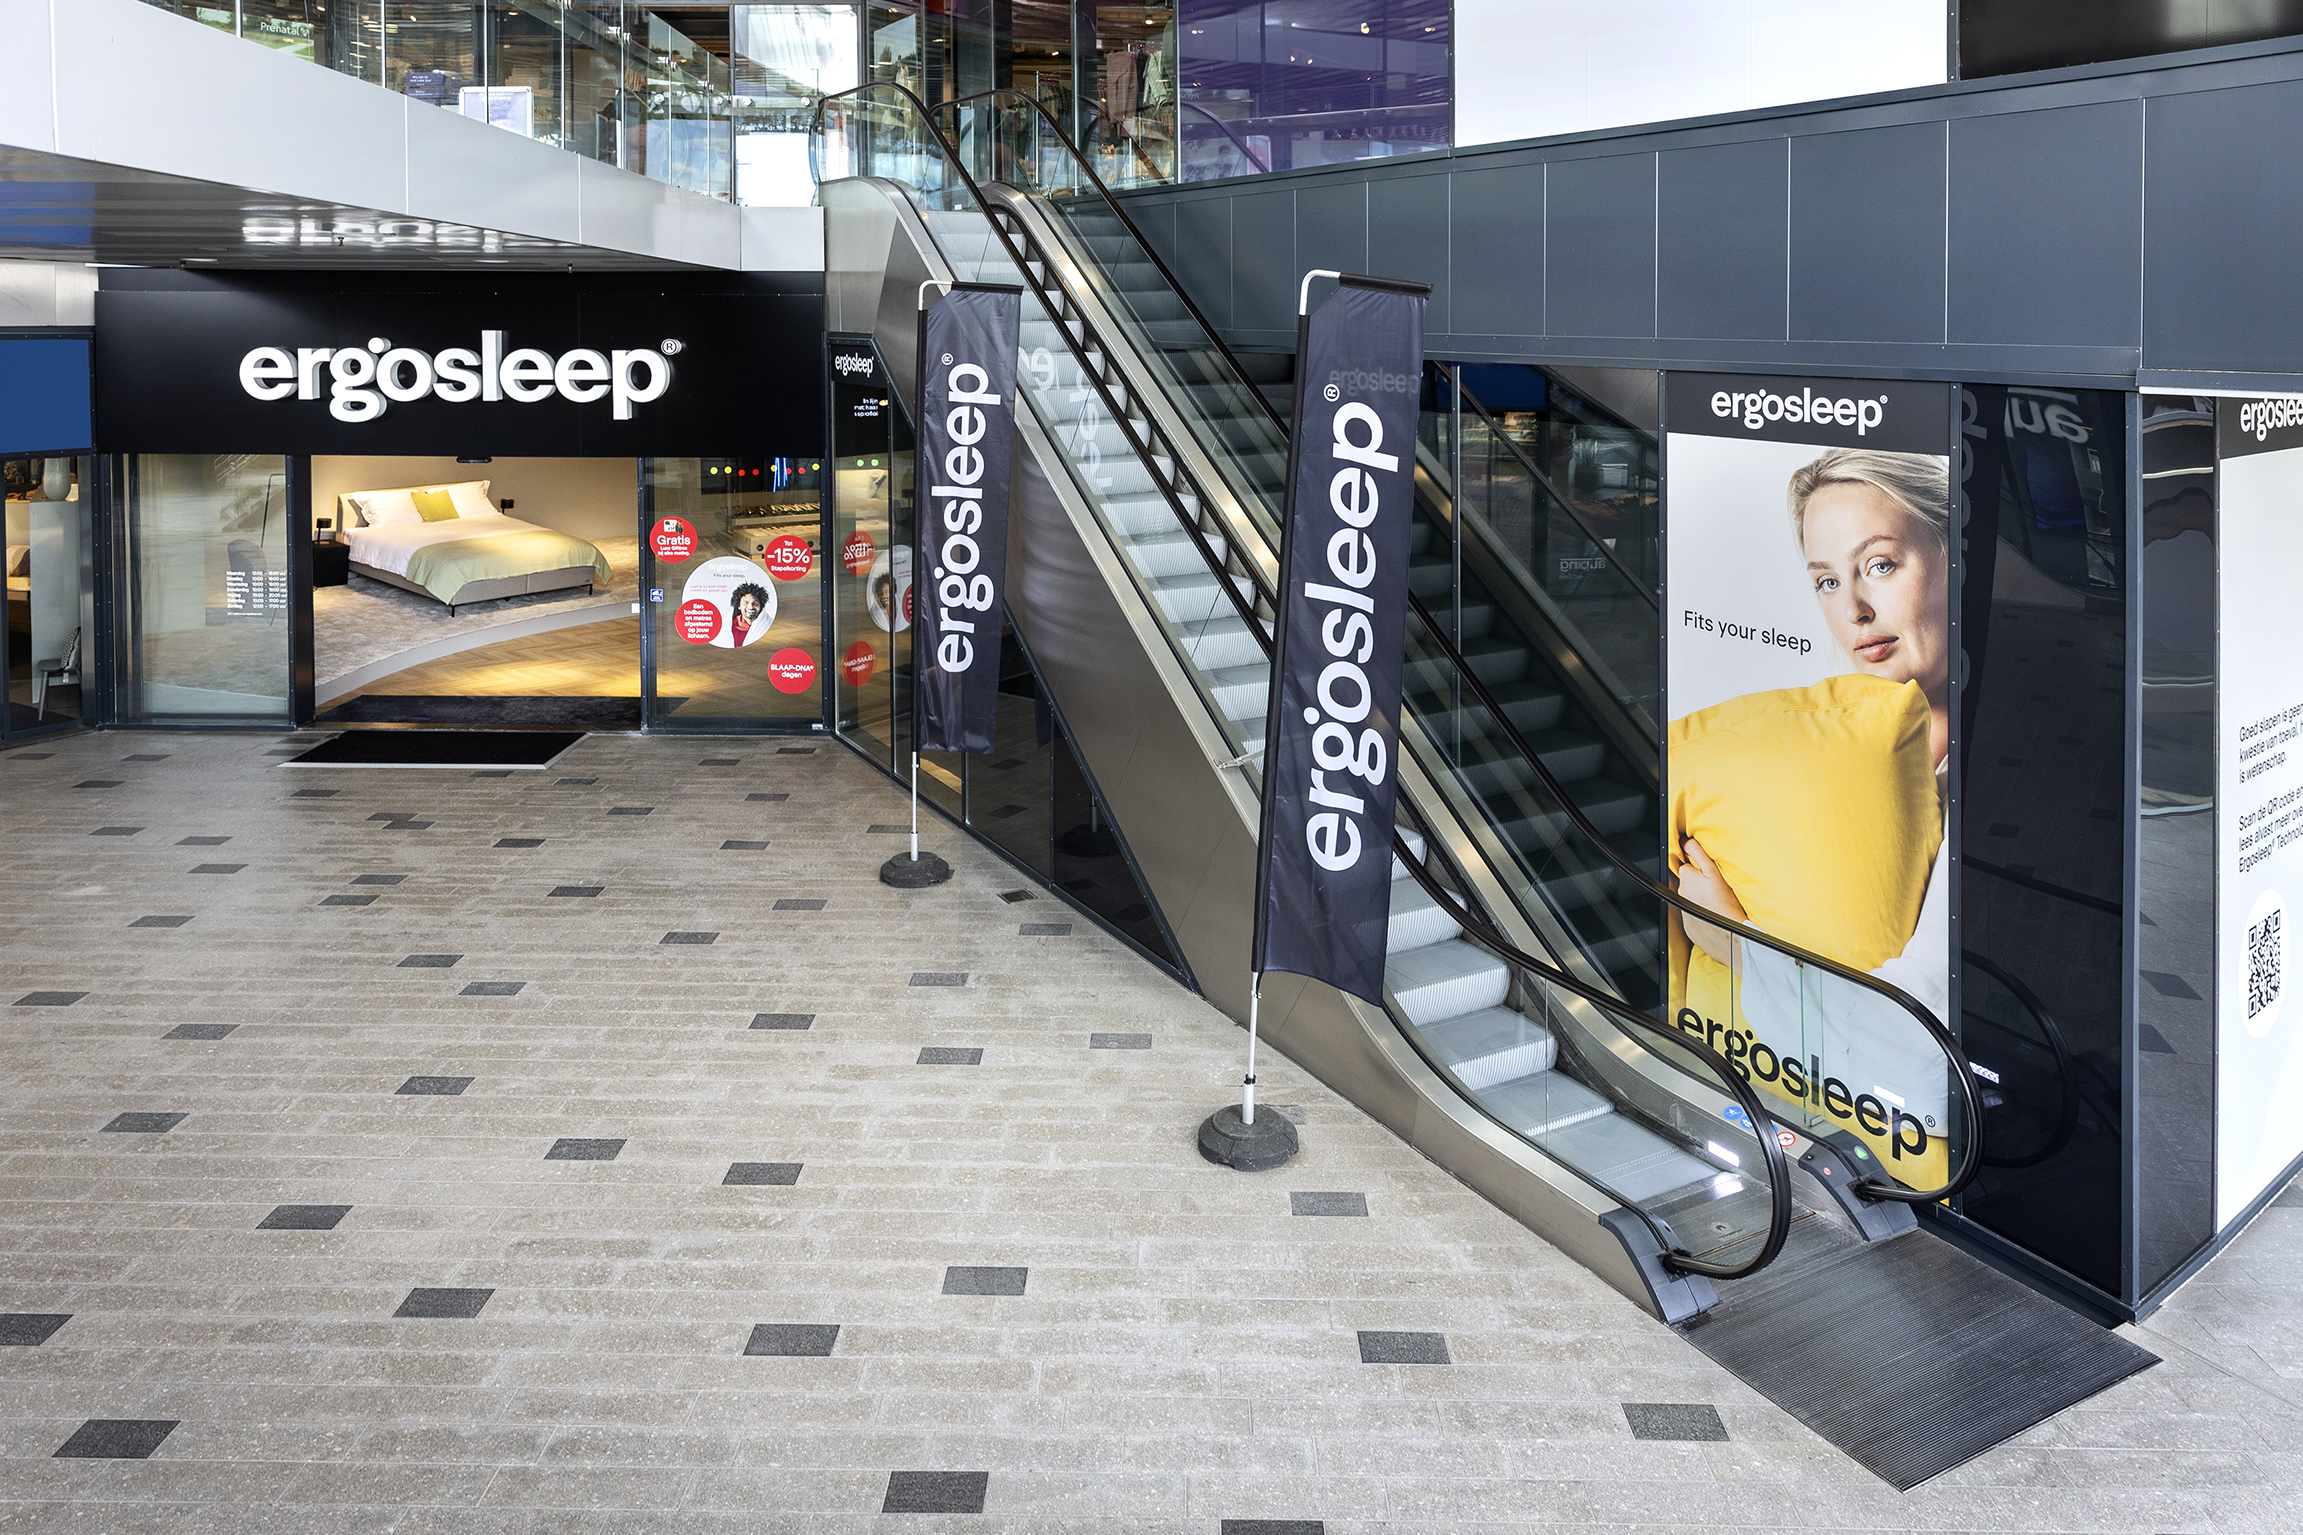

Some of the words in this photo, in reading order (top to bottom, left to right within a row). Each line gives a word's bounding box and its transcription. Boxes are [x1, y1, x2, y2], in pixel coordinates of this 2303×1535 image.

[2240, 397, 2303, 442] ergoslee
[656, 535, 691, 546] Gratis
[767, 548, 810, 564] -15%
[1684, 610, 1714, 632] Fits
[1718, 620, 1757, 639] your
[1761, 627, 1812, 656] sleep
[781, 671, 803, 679] dagen
[2240, 720, 2258, 742] Goed
[2260, 717, 2280, 733] slapen
[2282, 708, 2287, 723] is
[2240, 739, 2265, 763] kwestie
[2266, 735, 2277, 750] van
[2239, 769, 2245, 784] is
[2246, 751, 2287, 780] wetenschap.
[2239, 813, 2256, 831] Scan
[2257, 805, 2266, 821] de
[2267, 797, 2277, 815] QR
[2279, 789, 2295, 808] code
[2239, 835, 2253, 852] lees
[2254, 821, 2273, 843] alvast
[2275, 812, 2291, 831] meer
[2292, 806, 2303, 820] ove
[2277, 822, 2303, 849] Technolo
